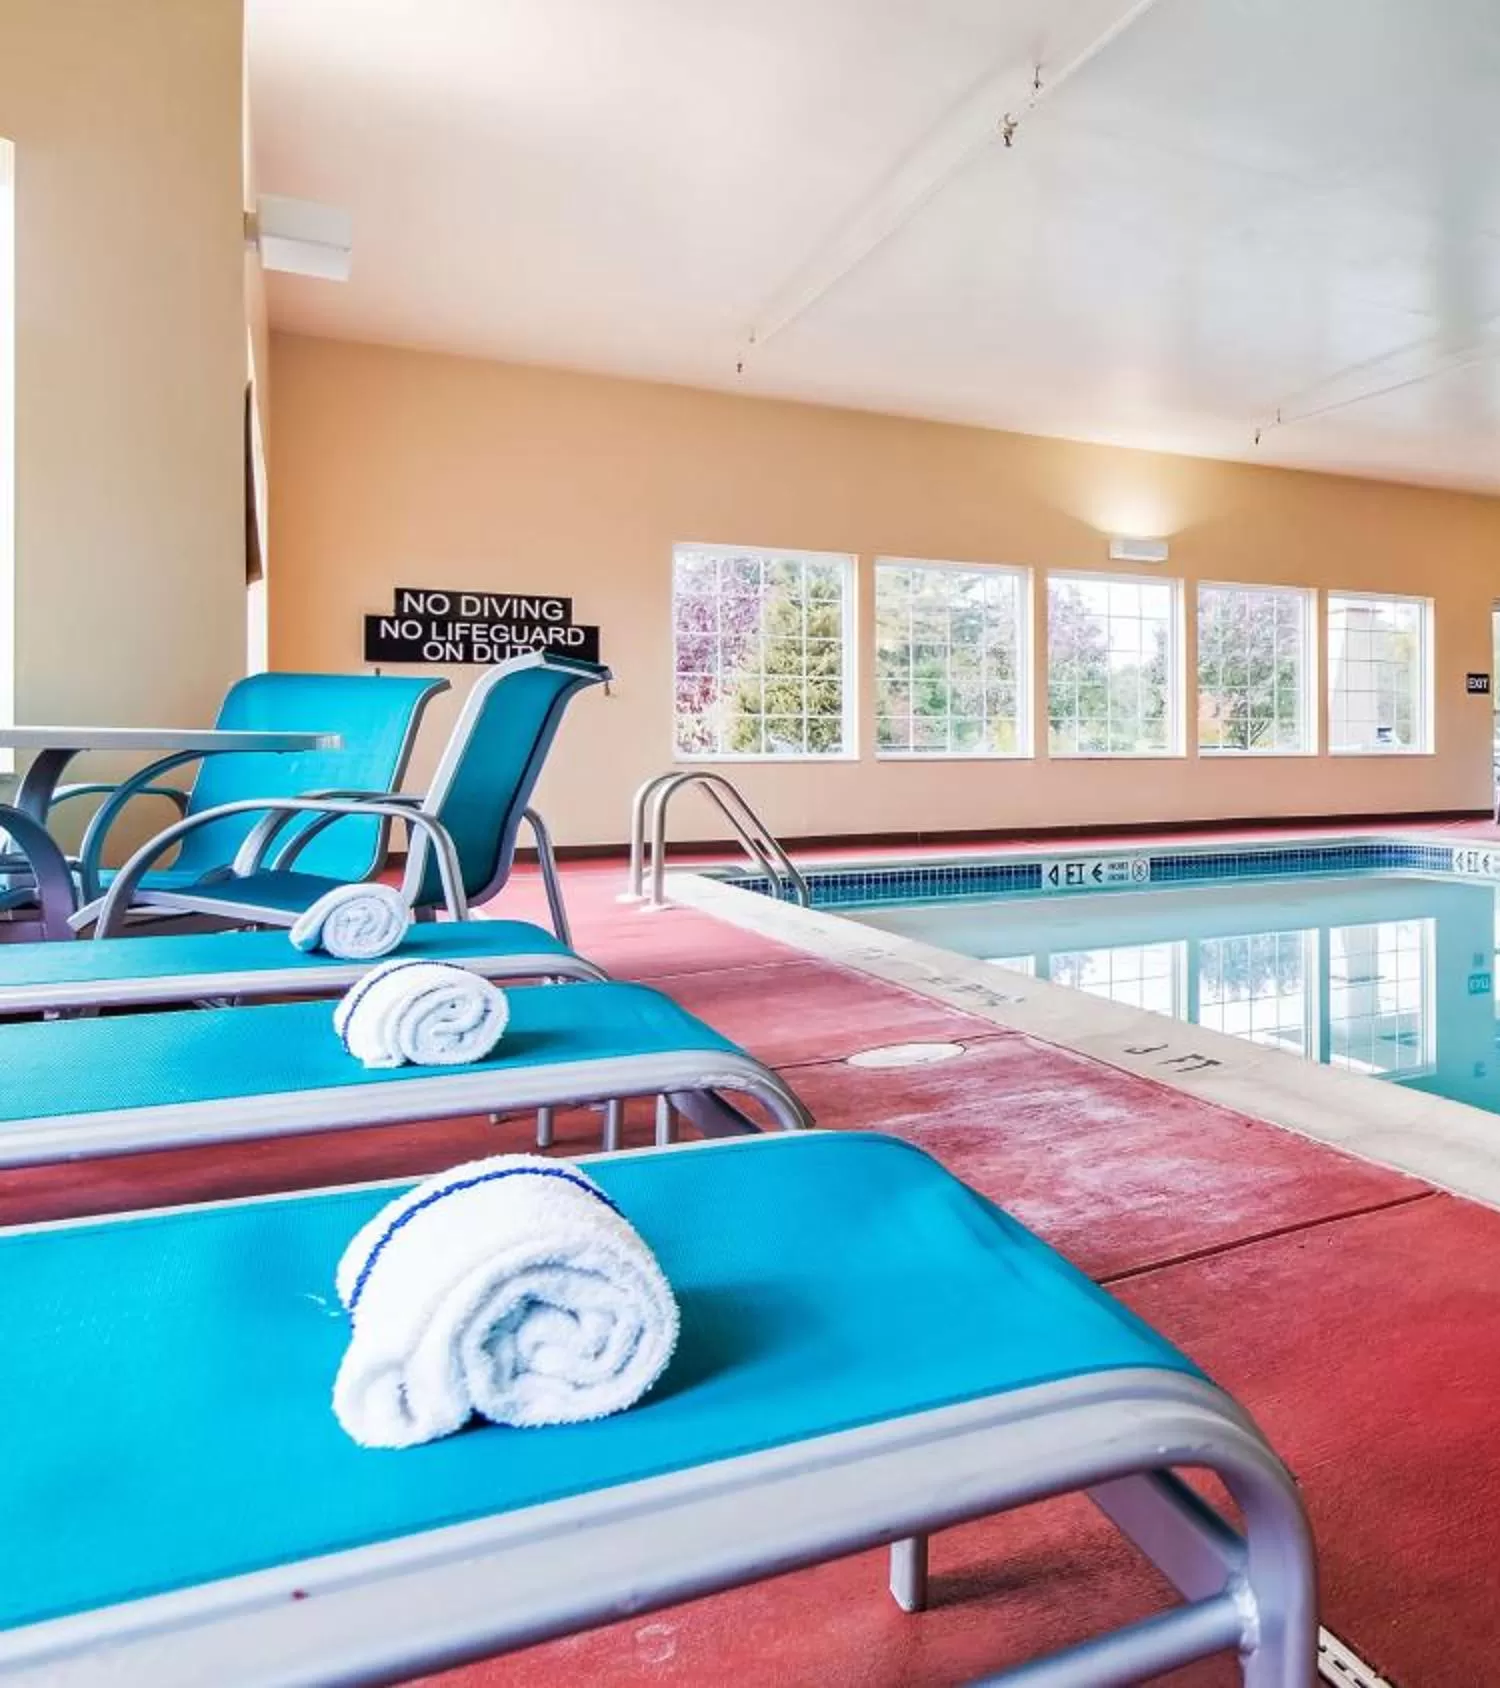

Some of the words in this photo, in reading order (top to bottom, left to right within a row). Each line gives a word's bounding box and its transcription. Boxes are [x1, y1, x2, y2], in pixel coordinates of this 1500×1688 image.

[402, 591, 450, 615] NO
[461, 595, 564, 621] DIVING
[379, 619, 423, 640] NO
[431, 621, 585, 646] LIFEGUARD
[423, 641, 464, 661] ON
[1468, 677, 1488, 689] EXIT
